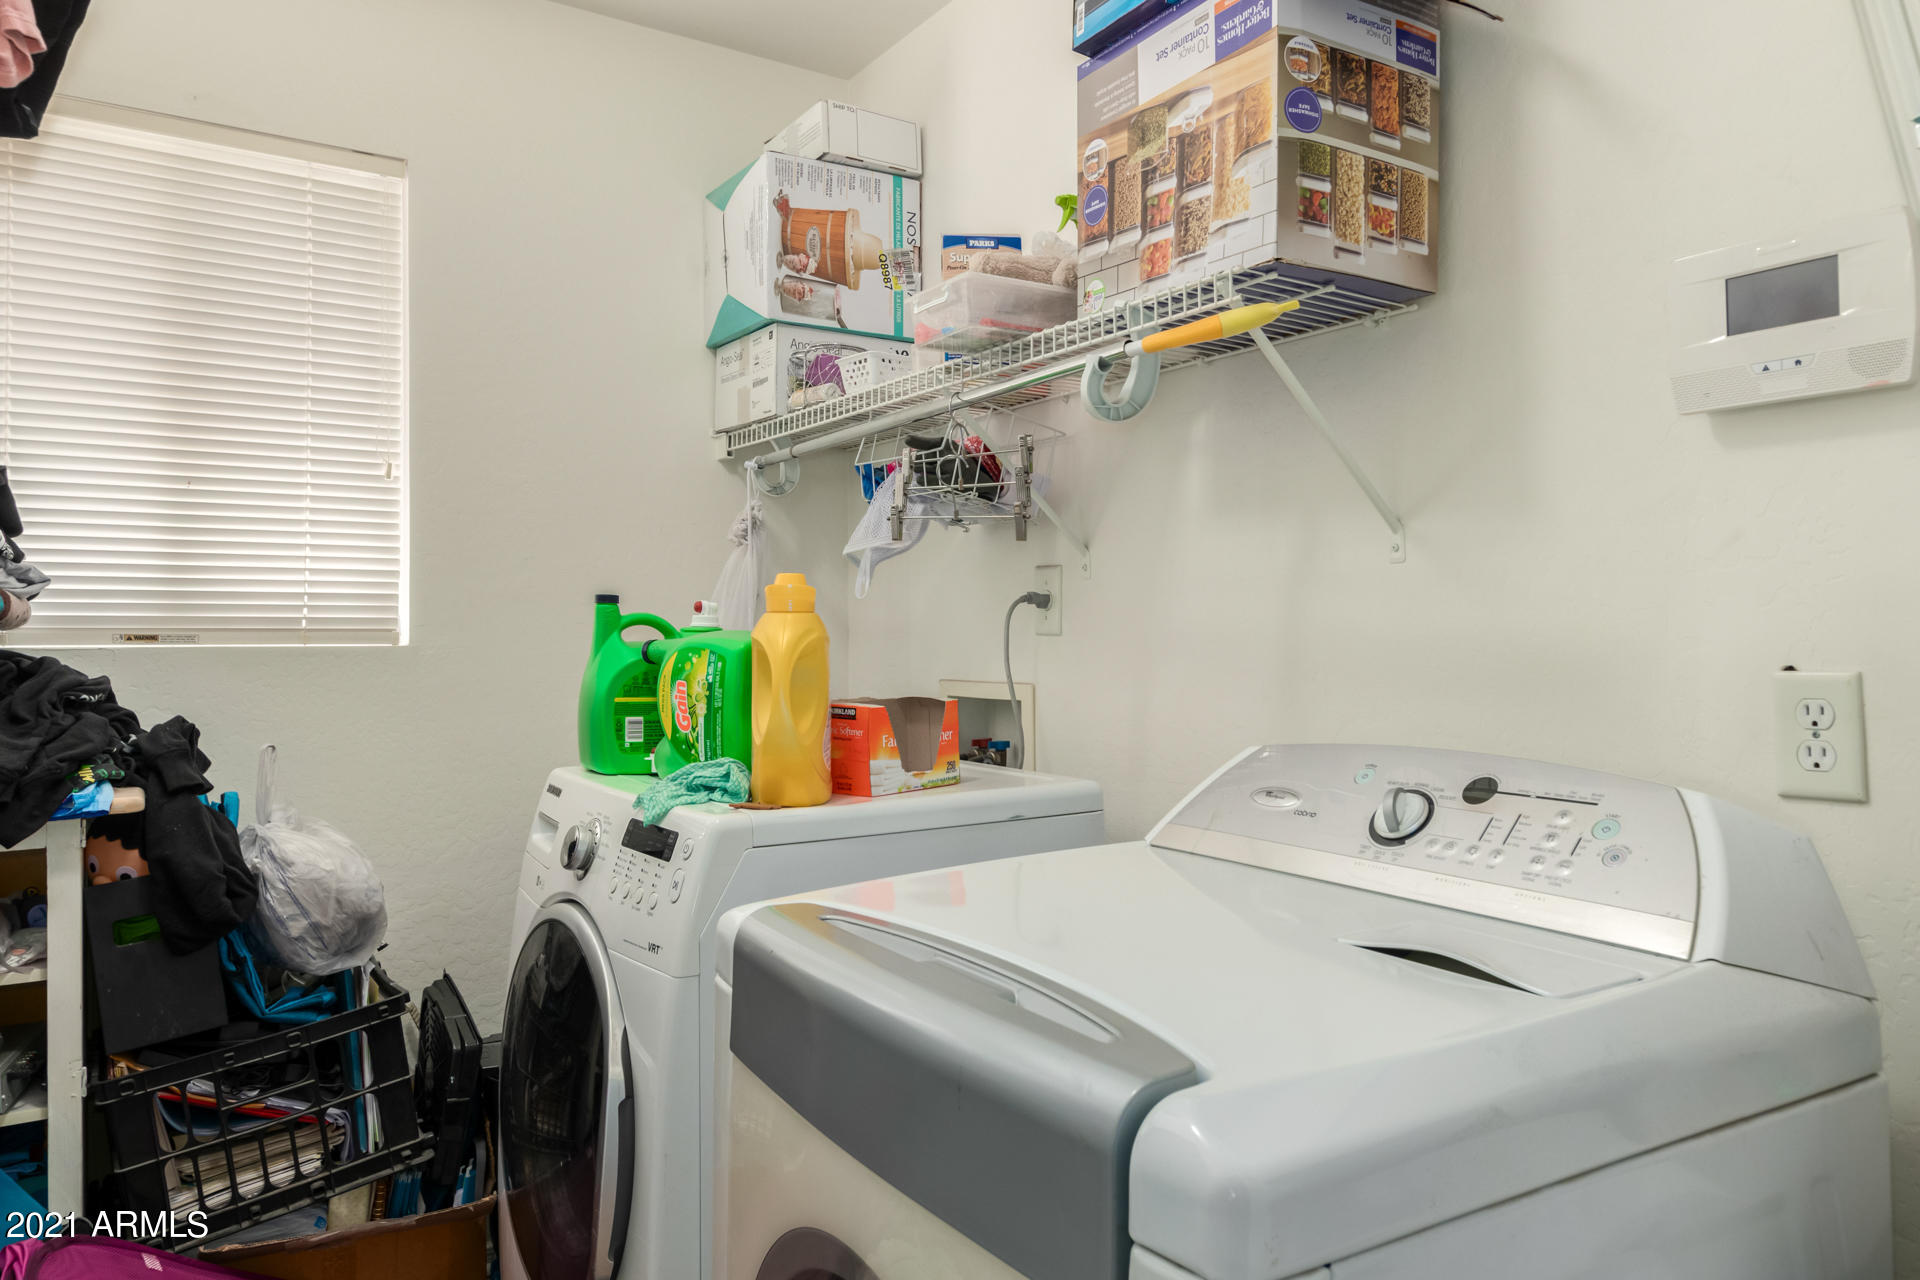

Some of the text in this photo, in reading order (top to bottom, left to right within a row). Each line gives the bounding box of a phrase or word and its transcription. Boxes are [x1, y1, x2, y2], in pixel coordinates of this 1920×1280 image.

[1345, 12, 1358, 24] Set
[1216, 21, 1246, 45] Homes
[1358, 18, 1392, 35] Container
[1155, 23, 1210, 62] Container Set
[1381, 34, 1393, 46] 10
[1176, 36, 1210, 60] 10 PACK
[1287, 107, 1320, 118] DISHWASHER
[894, 187, 902, 222] FABRICANTE
[968, 239, 995, 247] PARKS
[950, 252, 969, 265] Sup
[878, 253, 893, 291] Q8987
[674, 680, 692, 733] Gain
[831, 708, 856, 716] KIRKLAND
[648, 941, 661, 955] VRT
